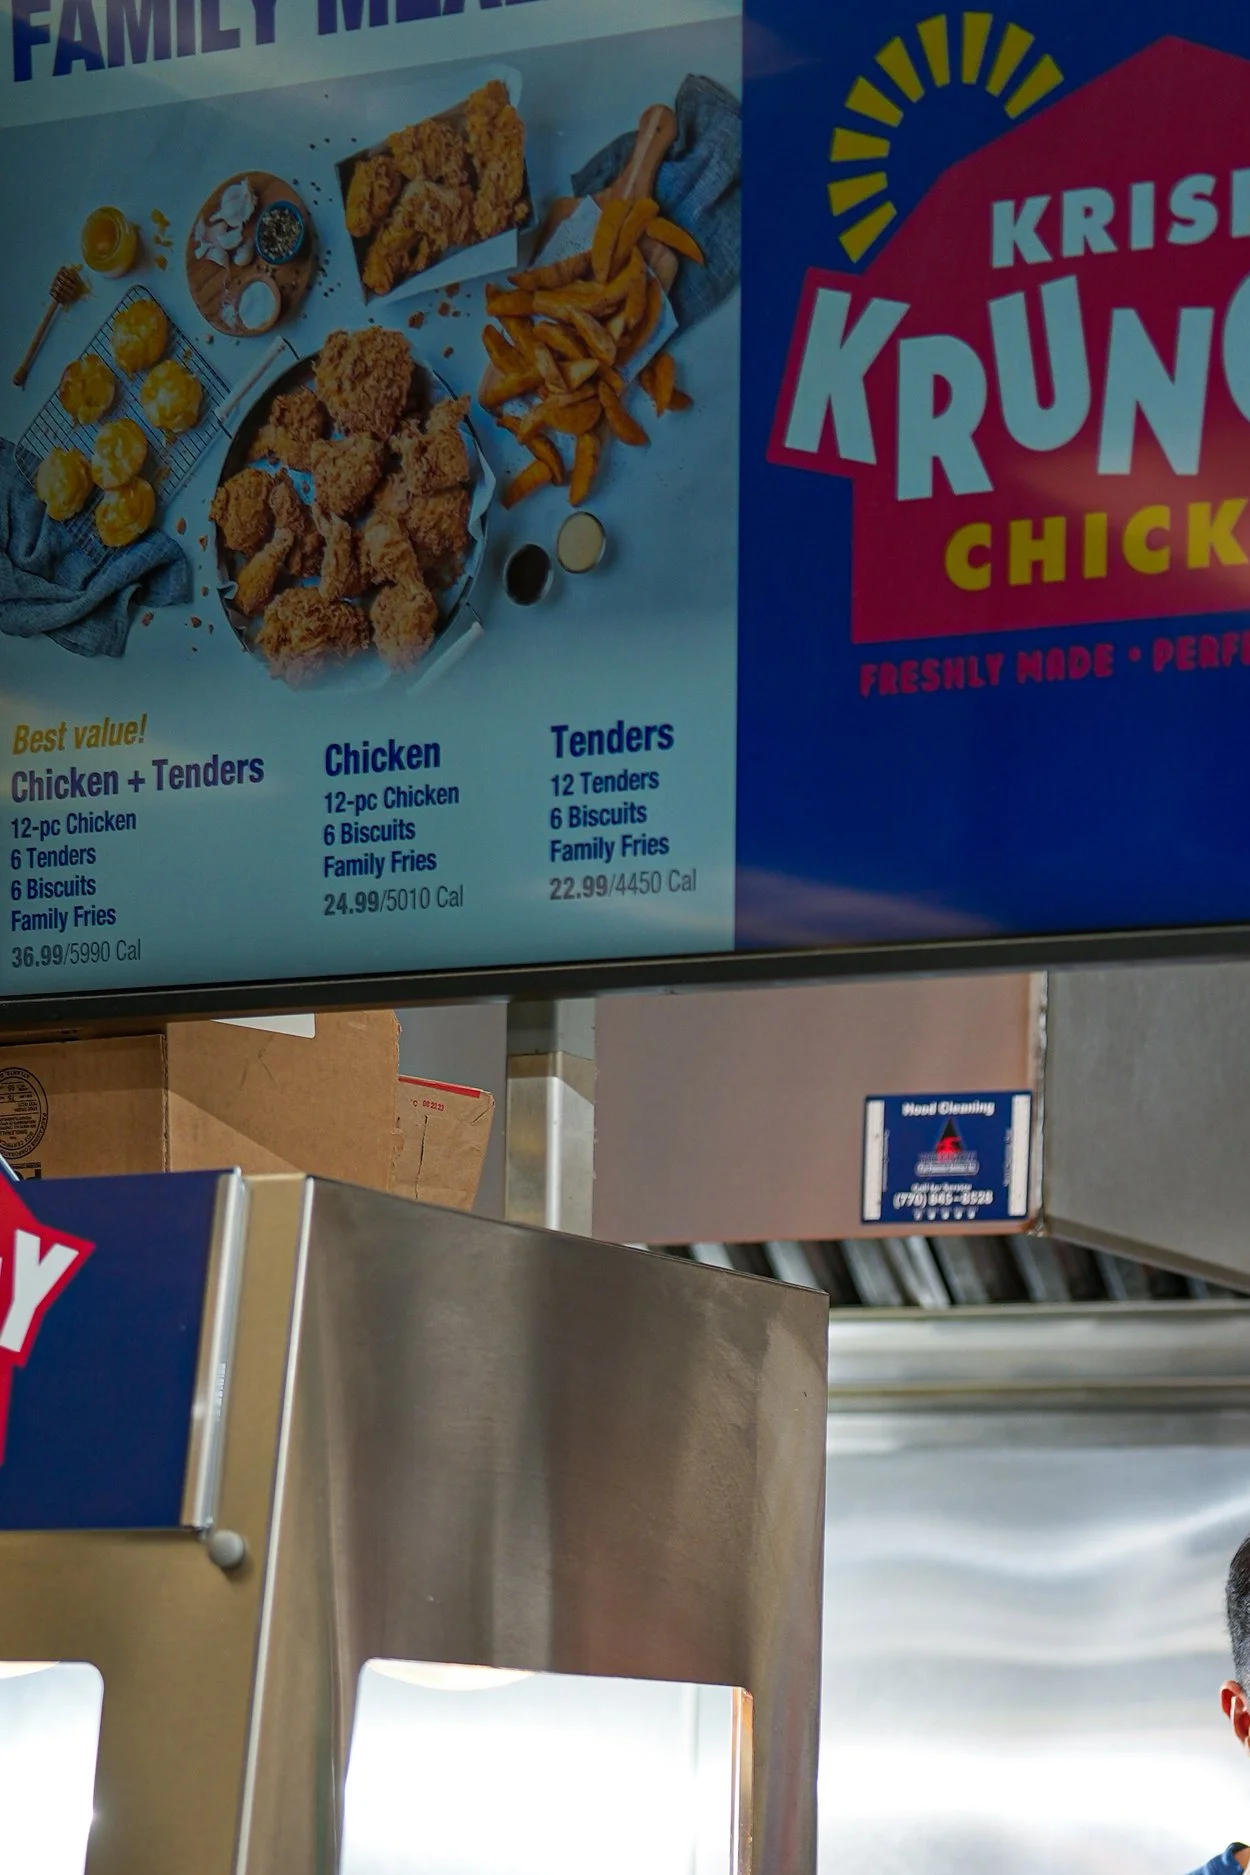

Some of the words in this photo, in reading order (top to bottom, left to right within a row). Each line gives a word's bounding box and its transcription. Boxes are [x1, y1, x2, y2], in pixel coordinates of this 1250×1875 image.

[859, 652, 1003, 698] FRESHLY
[1017, 644, 1114, 685] MADE
[12, 722, 66, 755] Best
[74, 713, 148, 749] value!
[550, 719, 674, 759] Tenders
[325, 738, 441, 776] Chicken
[11, 765, 119, 803] Chicken
[152, 754, 265, 791] Tenders
[550, 773, 574, 797] 12
[580, 768, 659, 795] Tenders
[325, 790, 378, 816] 12-pc
[383, 784, 459, 809] Chicken
[11, 816, 61, 840] 12-pc
[66, 810, 137, 834] Chicken
[550, 807, 562, 830] 6
[569, 801, 647, 828] Biscuits
[323, 824, 335, 846] 6
[341, 819, 416, 845] Biscuits
[11, 849, 22, 870] 6
[27, 845, 96, 869] Tenders
[550, 837, 614, 863] Family
[622, 833, 670, 857] Fries
[324, 854, 385, 879] Family
[391, 850, 437, 873] Fries
[11, 880, 22, 900] 6
[27, 875, 96, 900] Biscuits
[549, 871, 662, 901] 22.99/4450
[668, 868, 697, 892] Cal
[323, 886, 431, 916] 24.99/5010
[436, 884, 464, 909] Cal
[11, 908, 68, 933] Family
[73, 906, 117, 928] Fries
[11, 941, 111, 968] 36.99/5990
[116, 938, 141, 962] Cal
